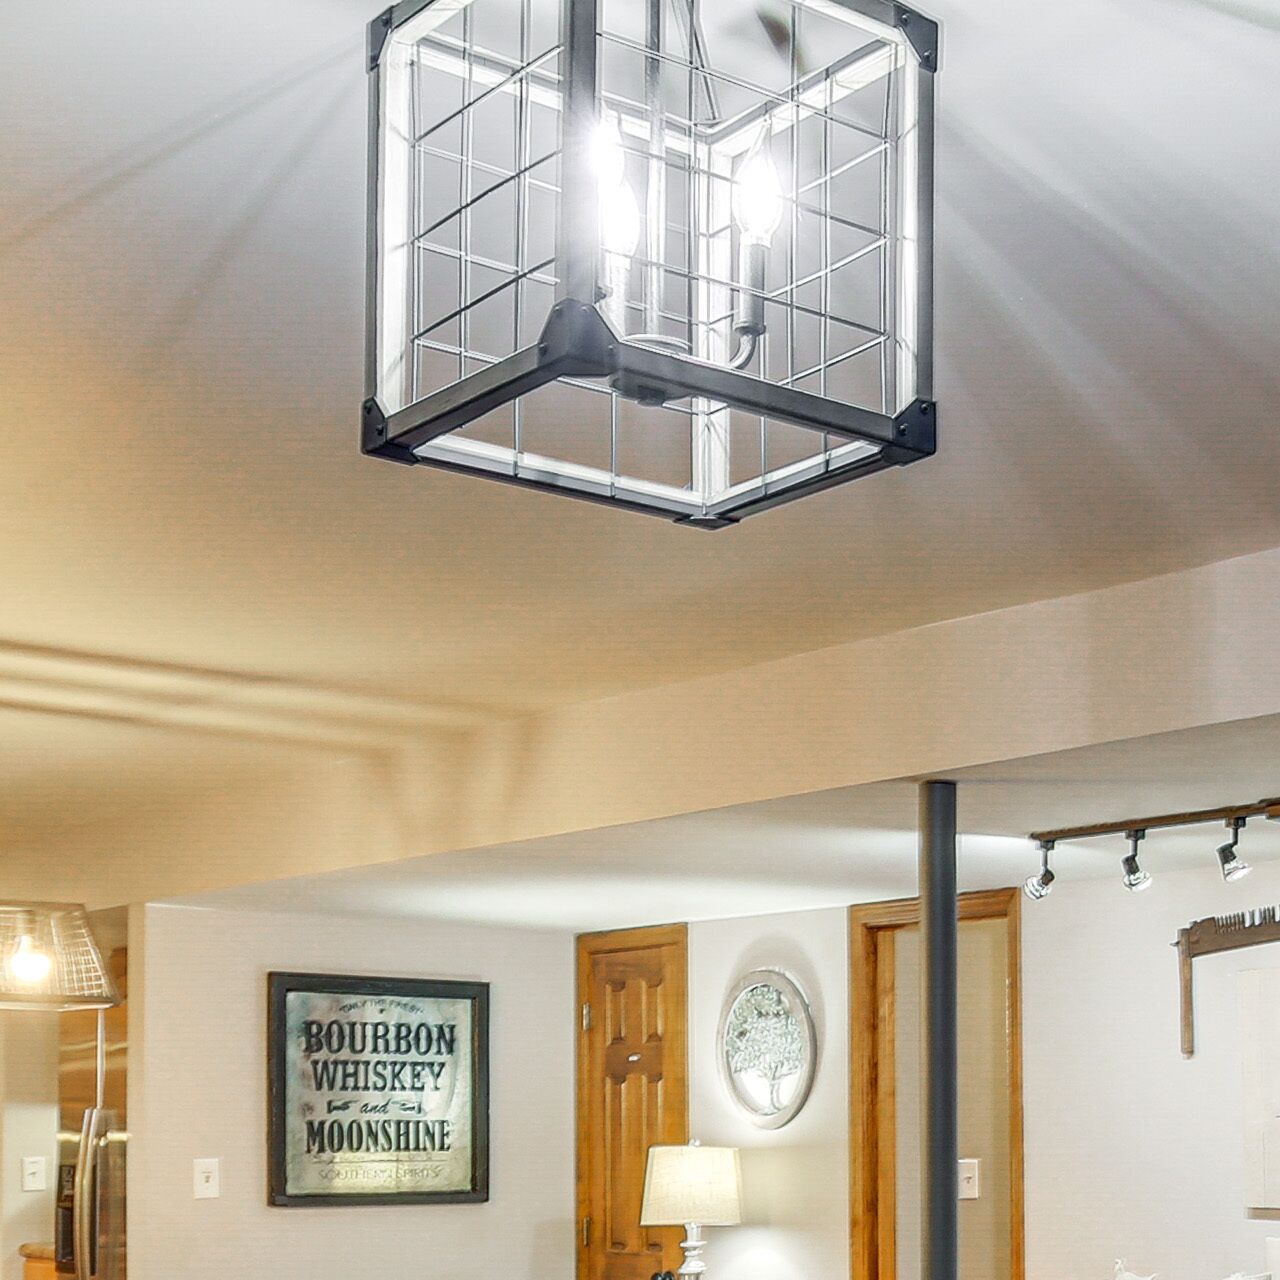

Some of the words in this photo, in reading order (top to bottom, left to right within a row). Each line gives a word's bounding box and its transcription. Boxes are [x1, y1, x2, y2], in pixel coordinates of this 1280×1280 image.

[301, 1020, 456, 1056] BOURBON
[310, 1059, 446, 1092] WHISKEY
[360, 1098, 392, 1114] and
[305, 1119, 451, 1154] MOONSHINE
